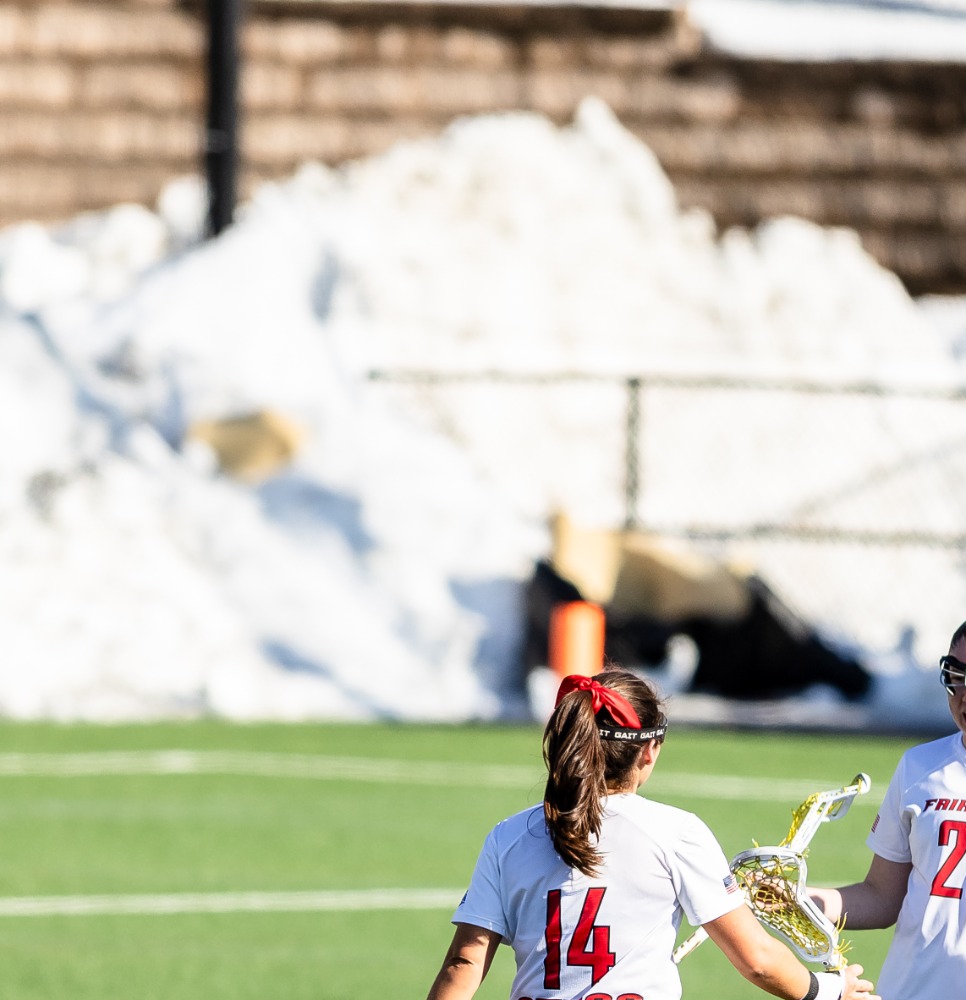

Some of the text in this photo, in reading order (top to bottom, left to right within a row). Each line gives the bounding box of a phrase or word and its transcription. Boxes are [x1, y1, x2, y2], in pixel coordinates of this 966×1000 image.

[614, 731, 638, 739] GAIT
[640, 731, 656, 739] GAIT
[543, 887, 616, 990] 14
